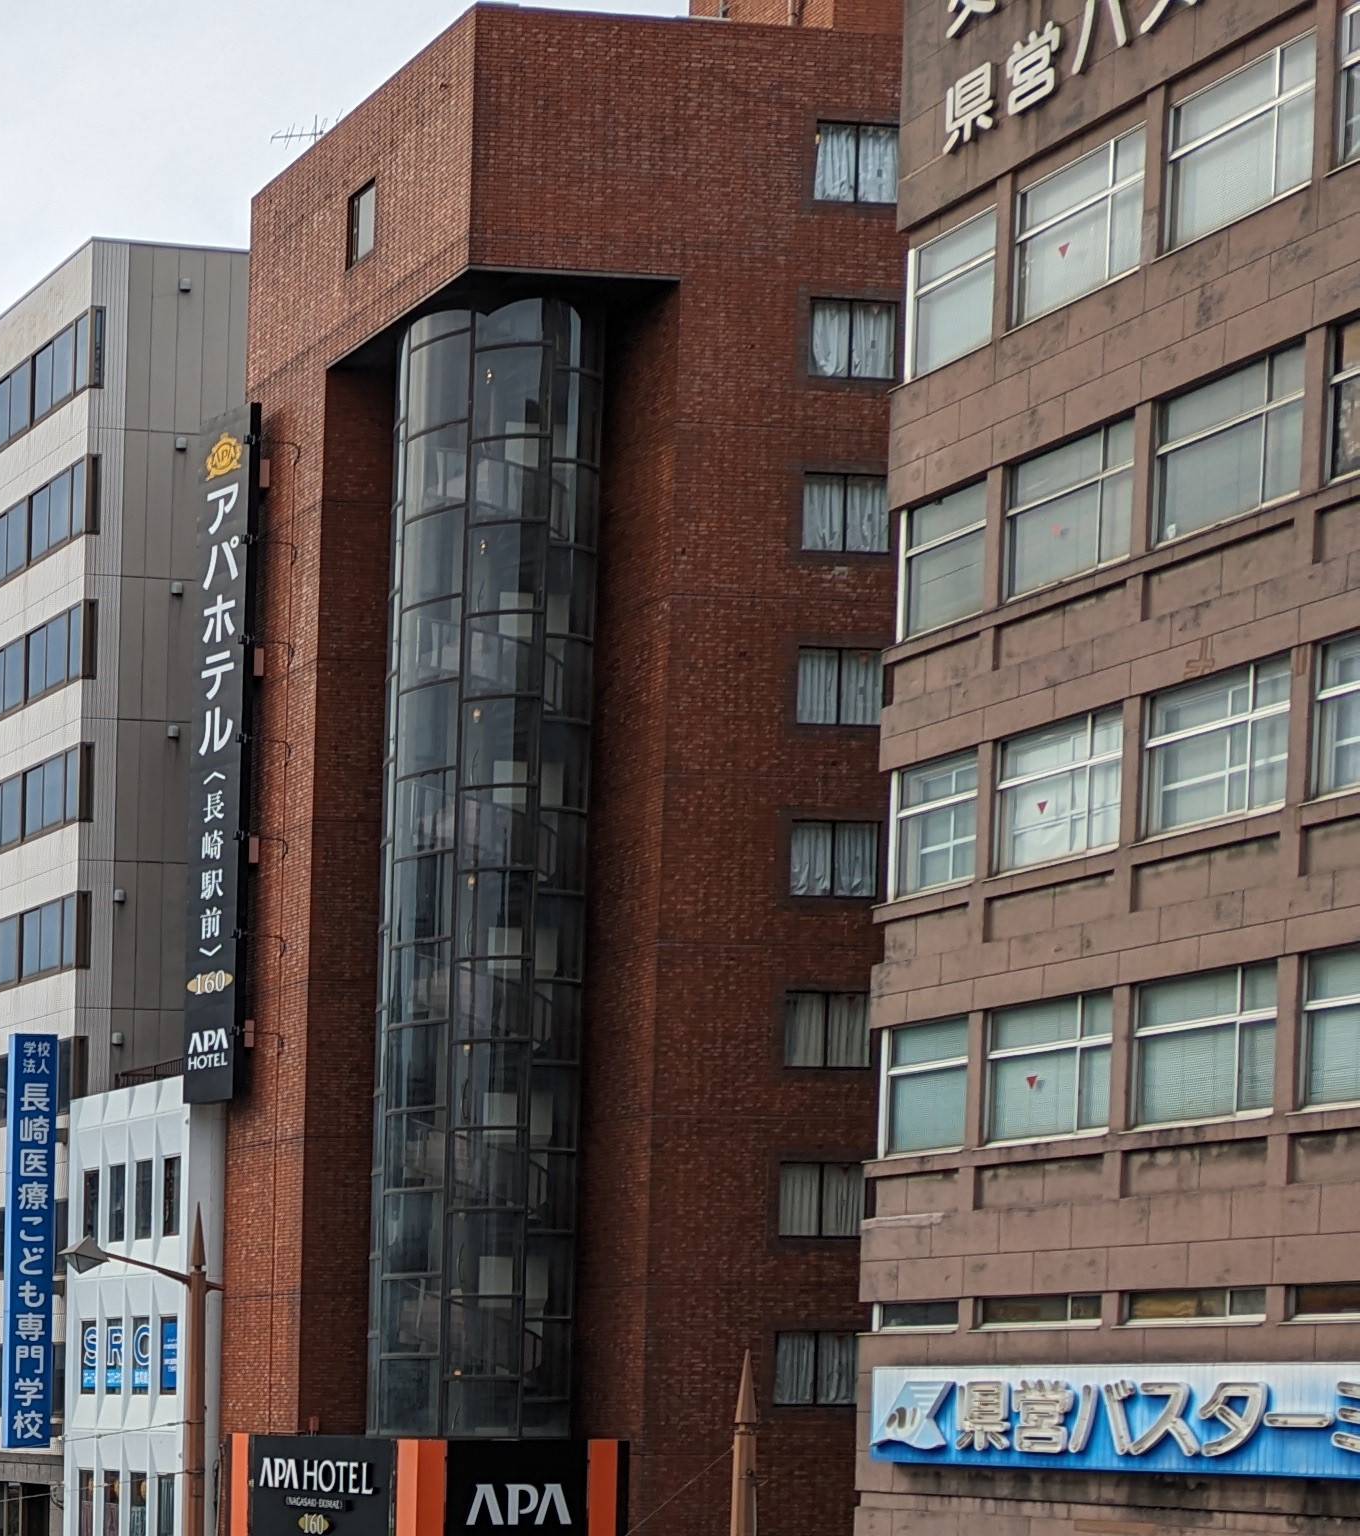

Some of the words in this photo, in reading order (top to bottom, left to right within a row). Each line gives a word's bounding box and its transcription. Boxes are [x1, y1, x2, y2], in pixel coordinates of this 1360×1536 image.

[196, 482, 241, 758] アパホテル
[193, 968, 225, 997] 160
[21, 1040, 51, 1057] 学校
[187, 1029, 229, 1054] APA
[21, 1058, 50, 1075] 法人
[187, 1052, 229, 1069] HOTEL
[12, 1082, 51, 1440] 長崎医療こども専門学校
[258, 1456, 300, 1490] APA
[301, 1458, 374, 1495] HOTEL
[465, 1482, 573, 1526] APA
[302, 1512, 325, 1536] 160
